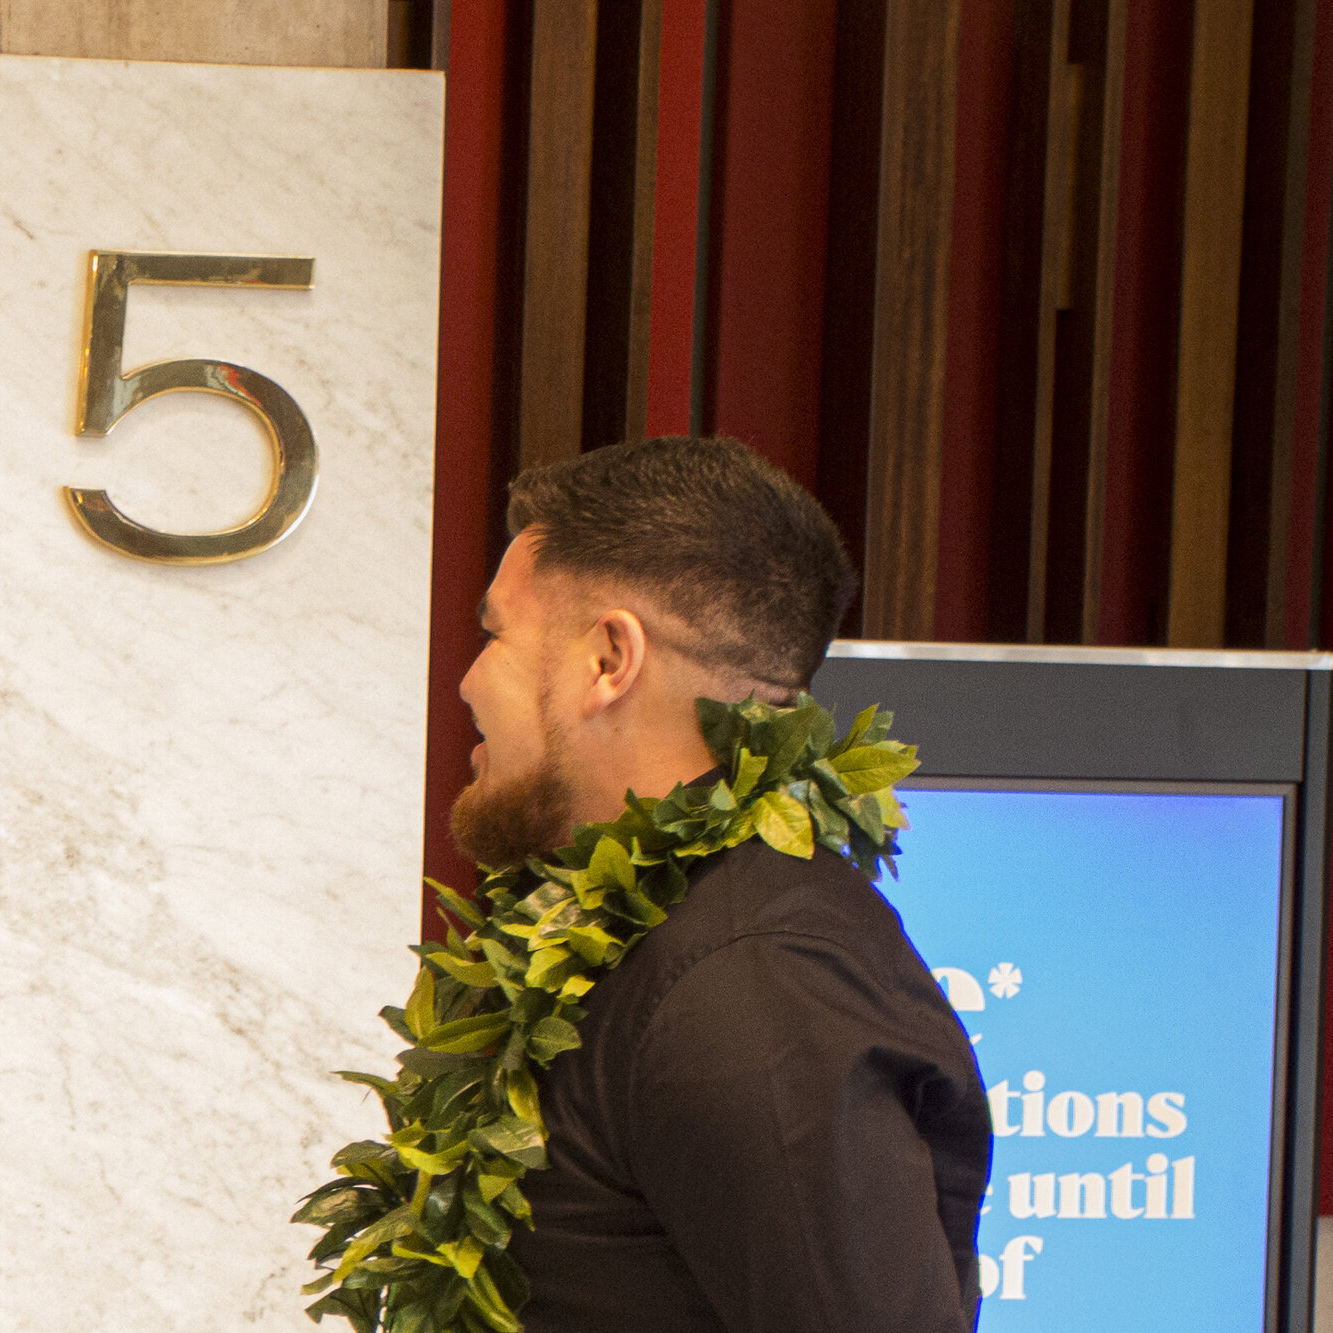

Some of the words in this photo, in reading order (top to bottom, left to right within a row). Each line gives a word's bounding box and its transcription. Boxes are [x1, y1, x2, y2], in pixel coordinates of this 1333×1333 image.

[63, 249, 320, 567] 5
[986, 1069, 1188, 1138] tions
[1007, 1152, 1196, 1219] until
